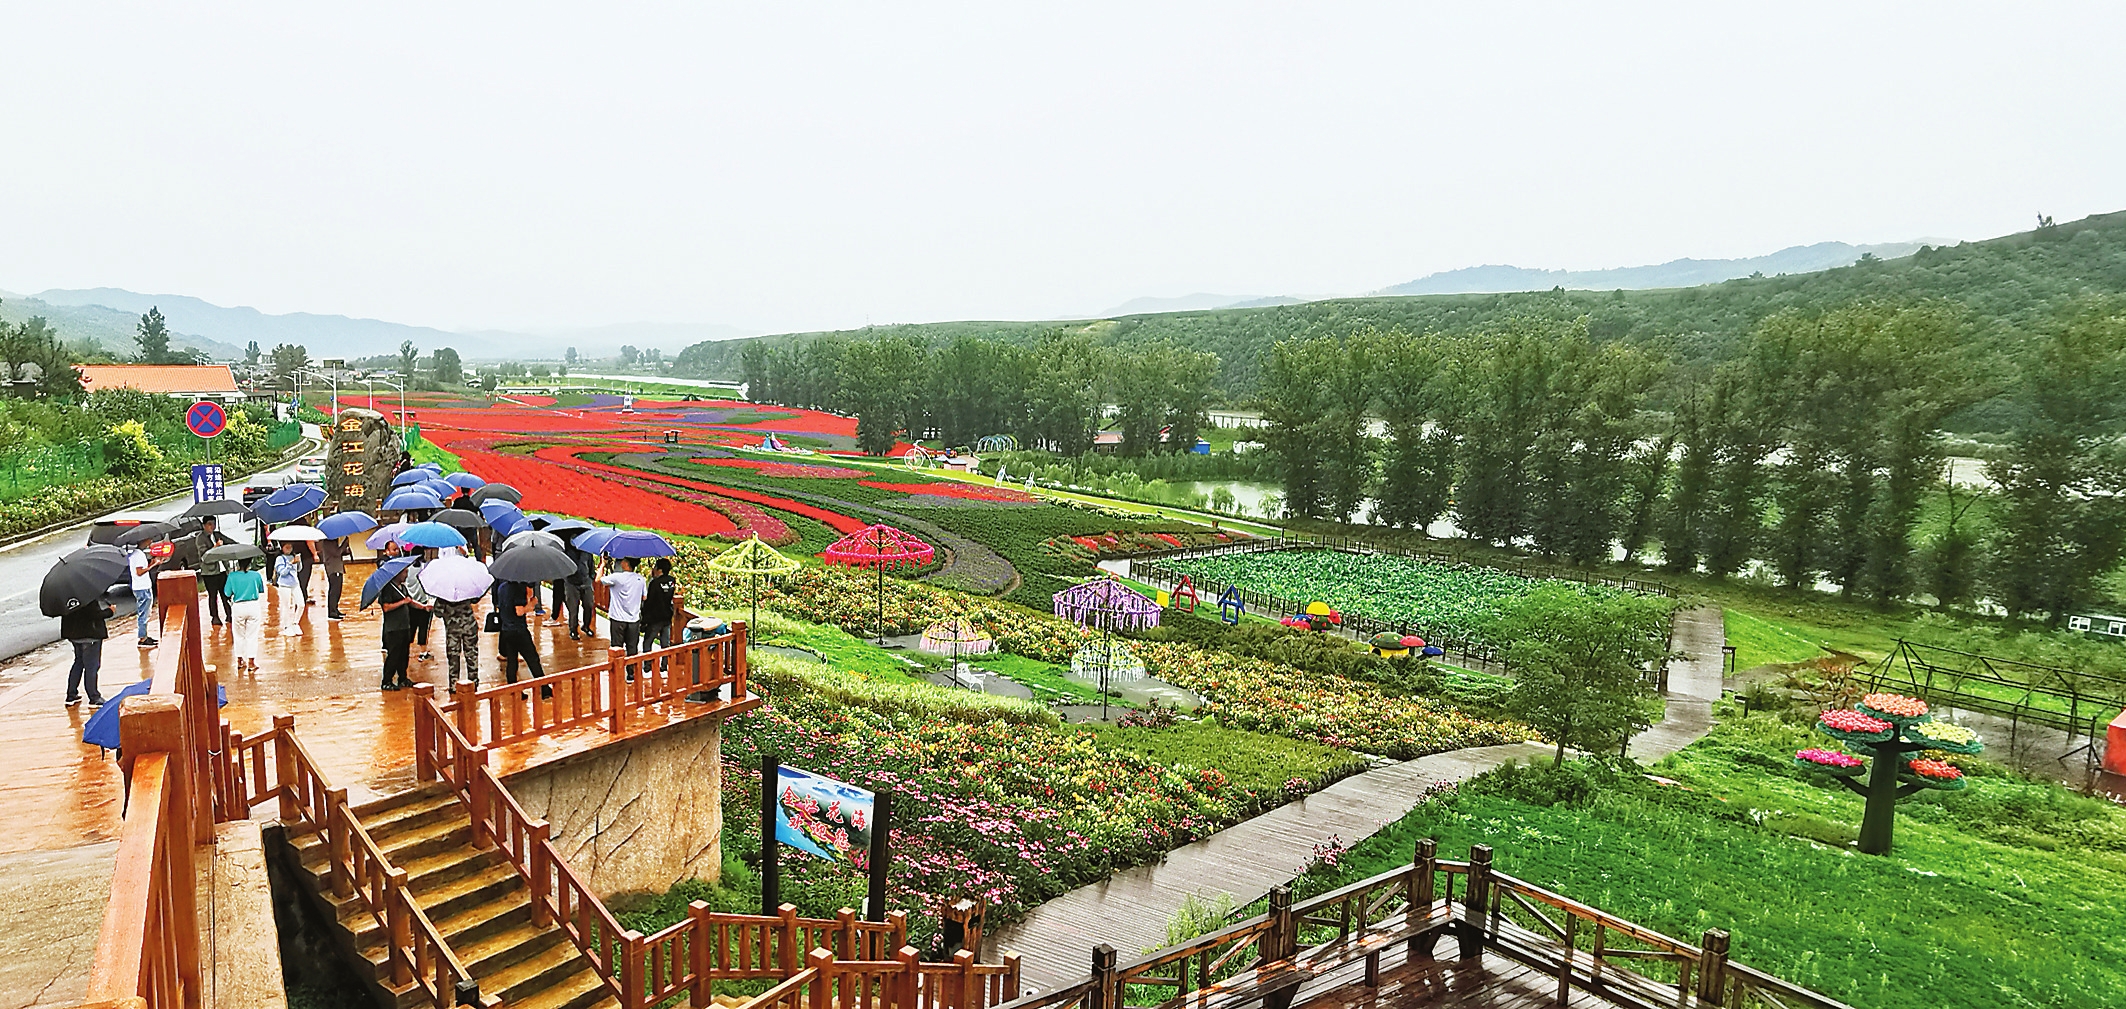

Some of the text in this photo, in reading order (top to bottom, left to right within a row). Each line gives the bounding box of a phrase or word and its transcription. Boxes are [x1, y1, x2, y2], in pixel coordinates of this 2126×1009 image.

[341, 418, 364, 497] 金江花海
[781, 786, 867, 831] 金江花海
[787, 814, 852, 852] 欢迎您
